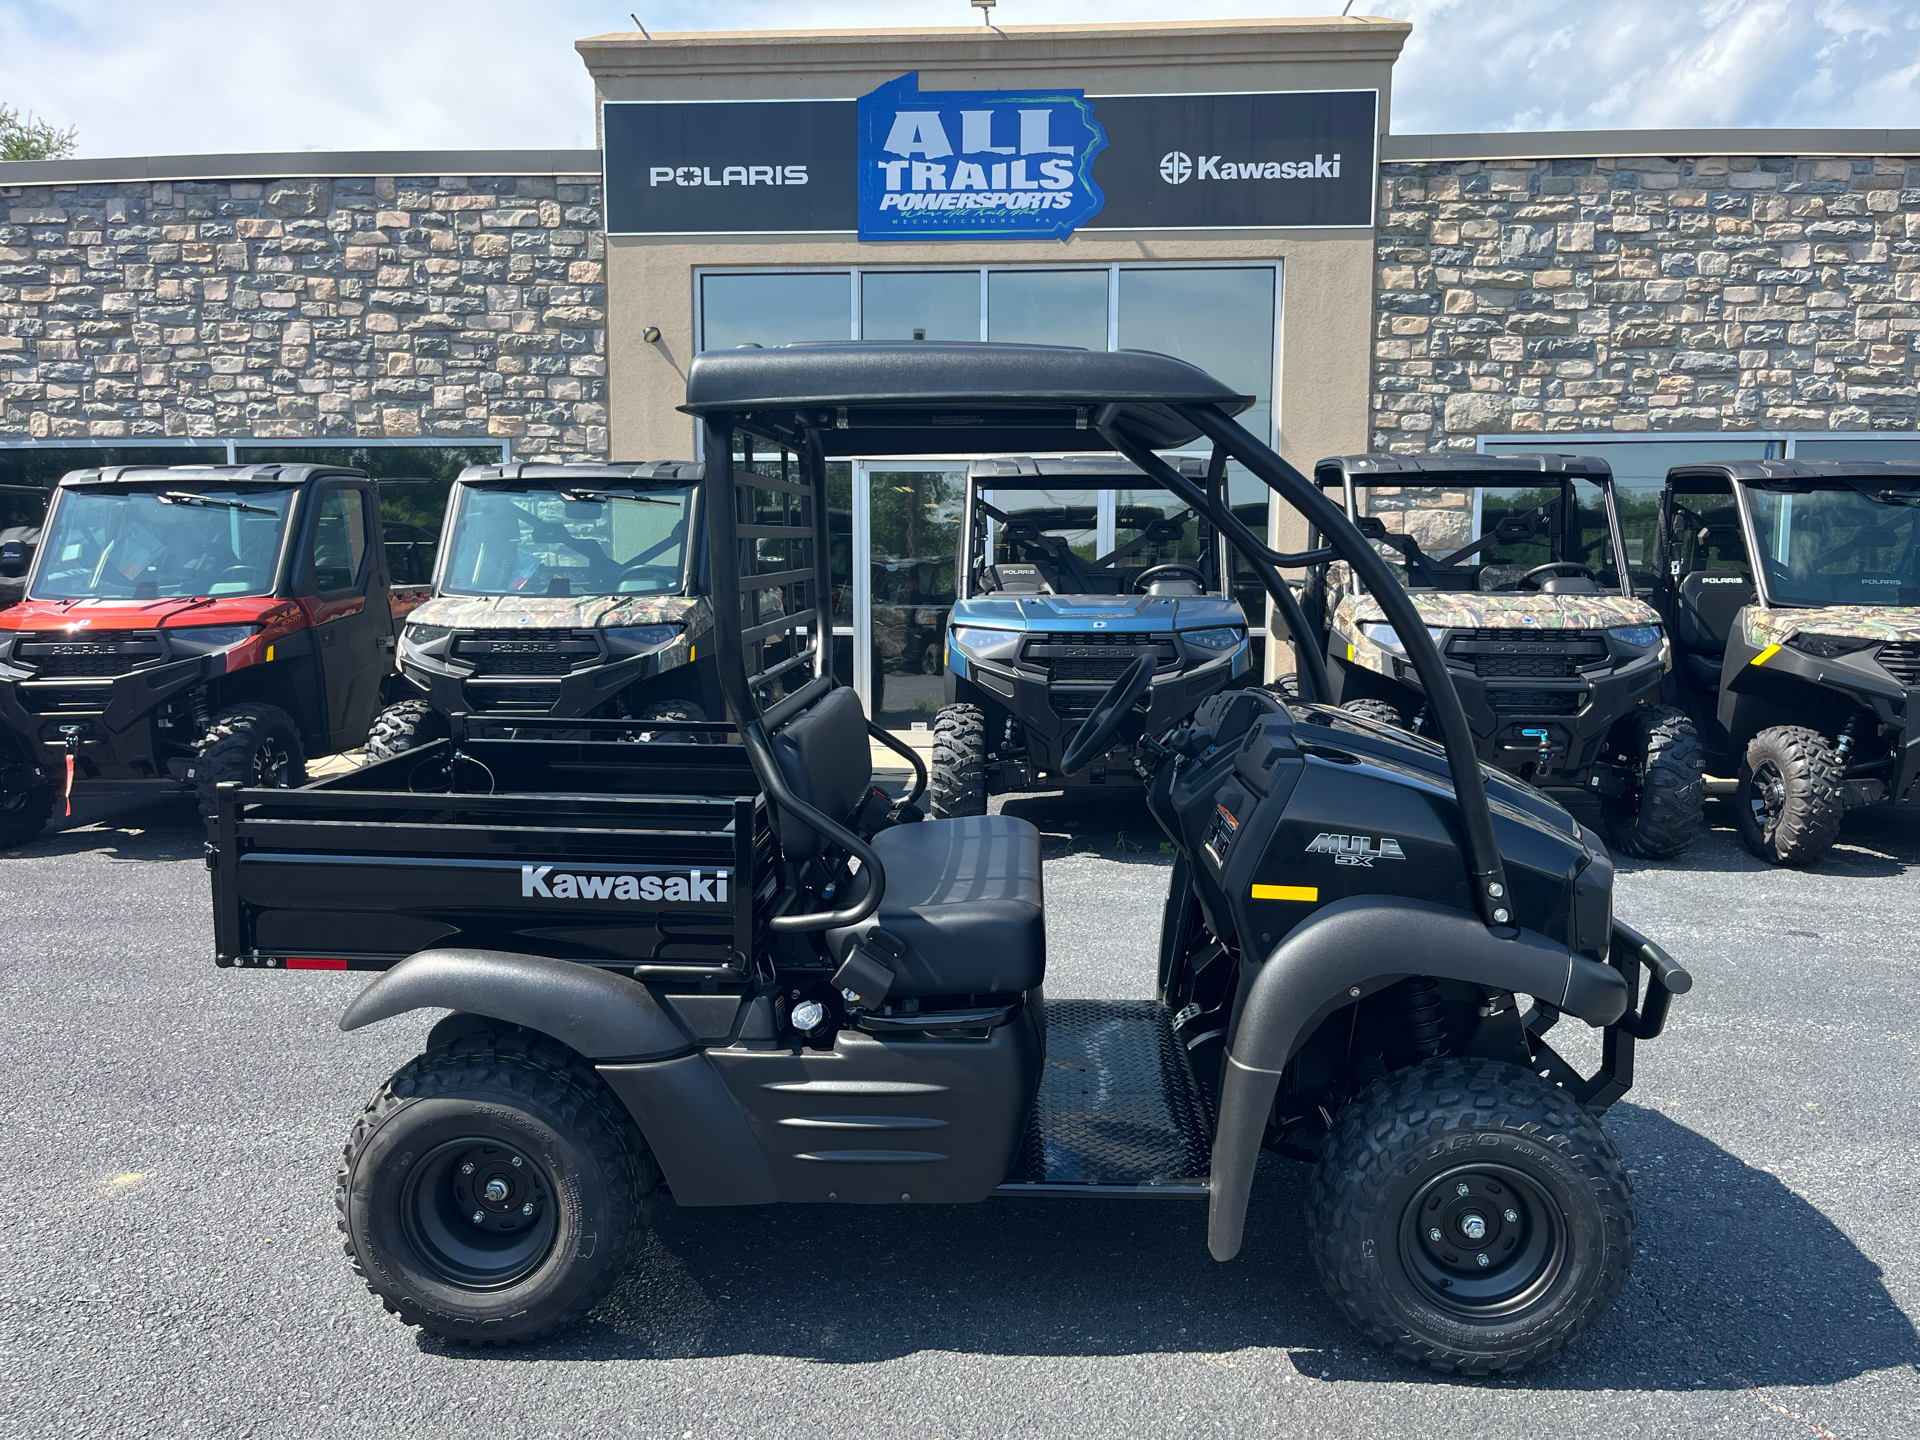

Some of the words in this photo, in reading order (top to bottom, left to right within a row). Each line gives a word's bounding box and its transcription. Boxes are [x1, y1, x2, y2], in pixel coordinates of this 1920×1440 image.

[883, 109, 1074, 160] ALL
[650, 165, 809, 187] POLARIS
[878, 158, 1075, 191] TRAILS
[1197, 153, 1342, 180] Kawasaki
[879, 191, 1074, 211] POWERSPORTS
[51, 645, 117, 655] POLARIS
[490, 644, 557, 653] POLARIS
[1064, 648, 1135, 657] POLARIS
[1492, 643, 1565, 653] POLARIS
[1305, 833, 1407, 860] MULE
[1335, 854, 1375, 868] SX
[522, 865, 728, 902] Kawasaki
[1404, 1133, 1501, 1177] DURO
